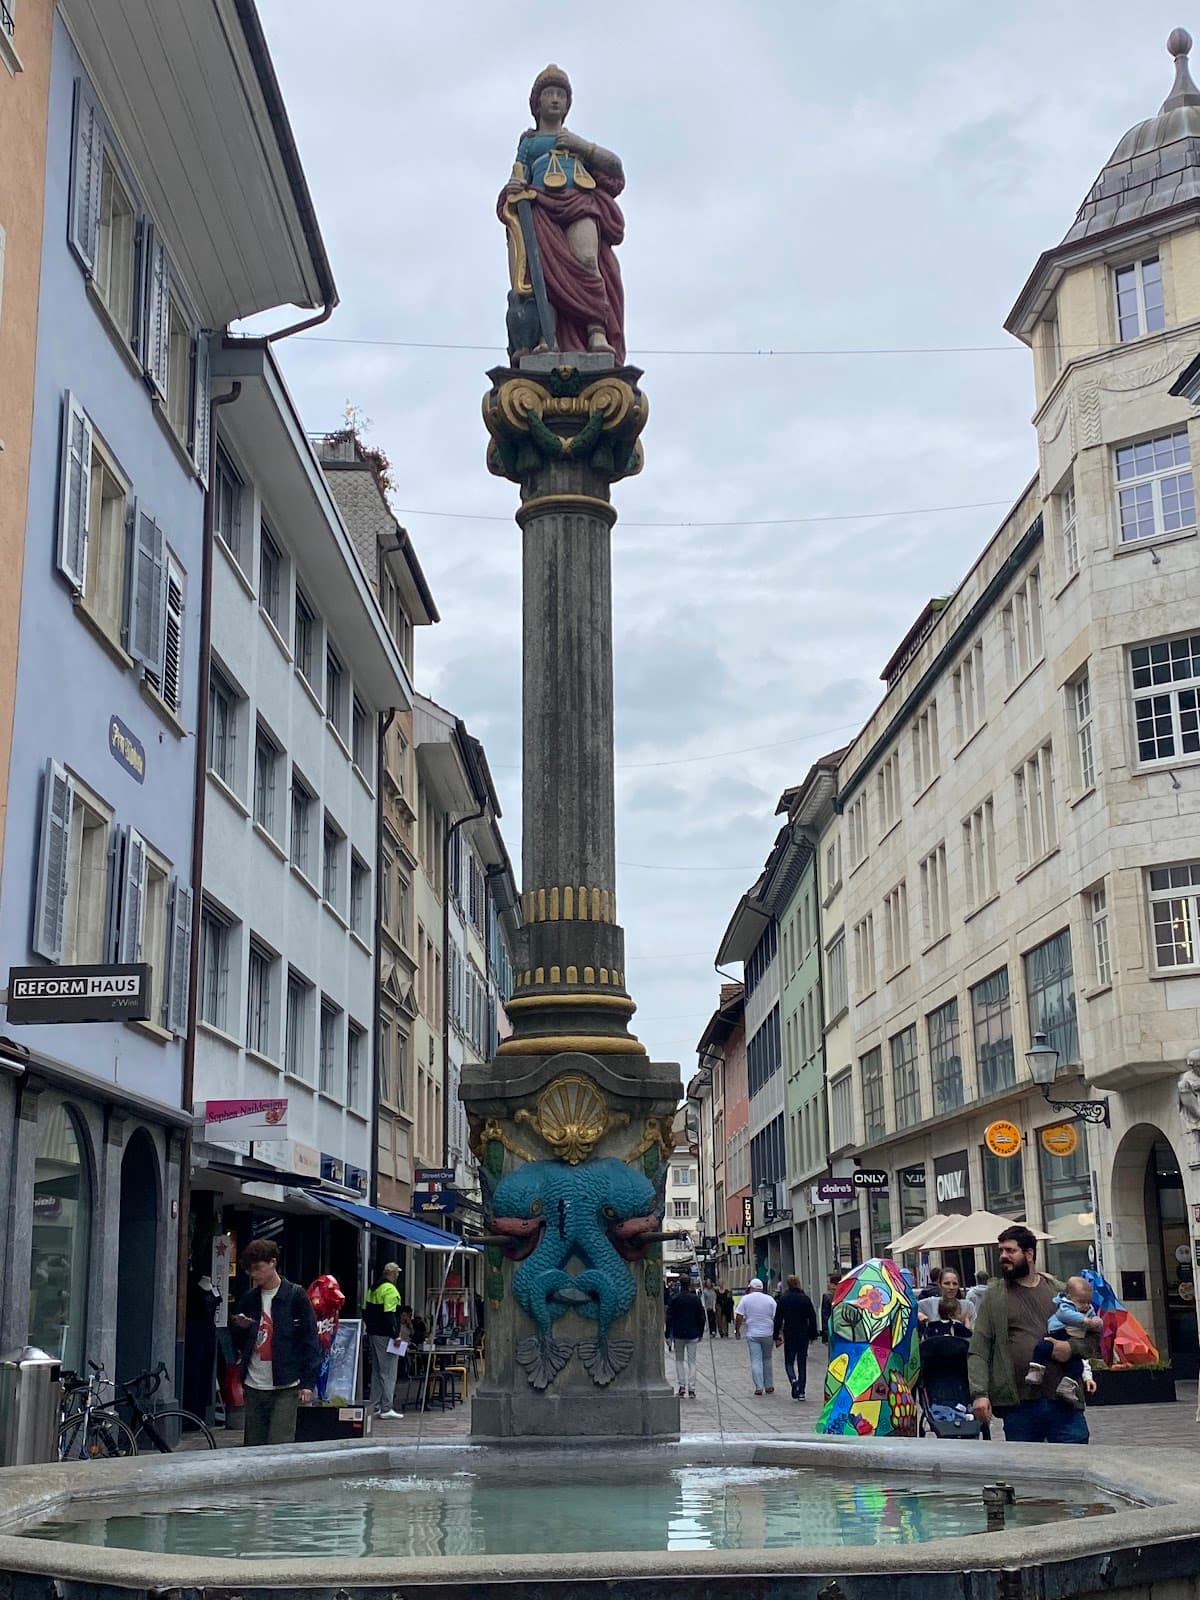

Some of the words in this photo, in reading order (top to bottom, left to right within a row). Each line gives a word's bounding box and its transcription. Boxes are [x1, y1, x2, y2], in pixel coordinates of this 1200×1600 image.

[18, 981, 85, 995] REFORM
[91, 979, 136, 992] HAUS
[854, 1174, 886, 1183] ONLY
[822, 1183, 852, 1193] claire's
[937, 1169, 965, 1202] ONLY
